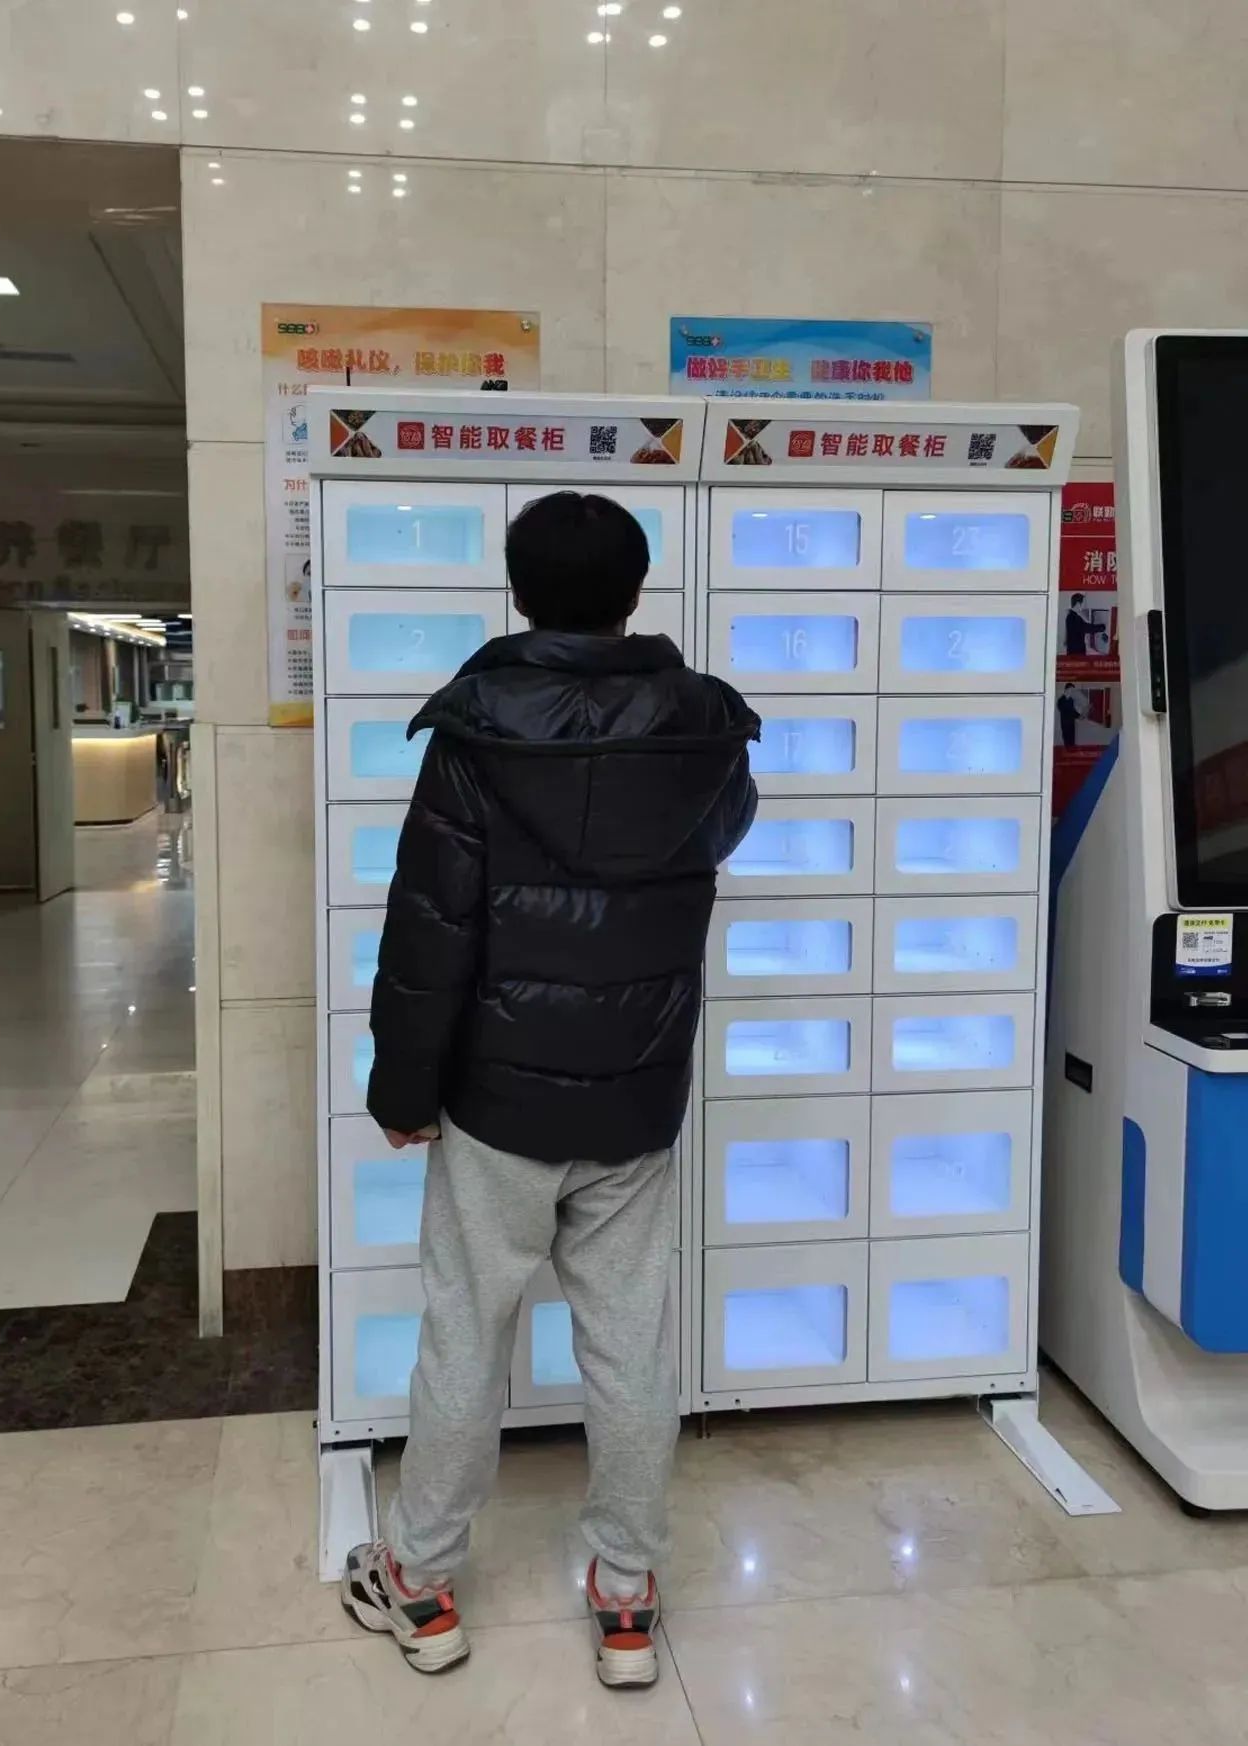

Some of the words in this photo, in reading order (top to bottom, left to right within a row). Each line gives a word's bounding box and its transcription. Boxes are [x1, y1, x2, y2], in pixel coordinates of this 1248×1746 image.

[687, 356, 793, 381] 做好手卫生
[811, 359, 914, 383] 健康你我他
[431, 424, 566, 451] 智能取餐柜
[820, 432, 947, 457] 智能取餐柜
[412, 520, 421, 549] 1
[785, 524, 809, 554] 15
[1082, 575, 1106, 585] HOW
[782, 628, 807, 659] 16
